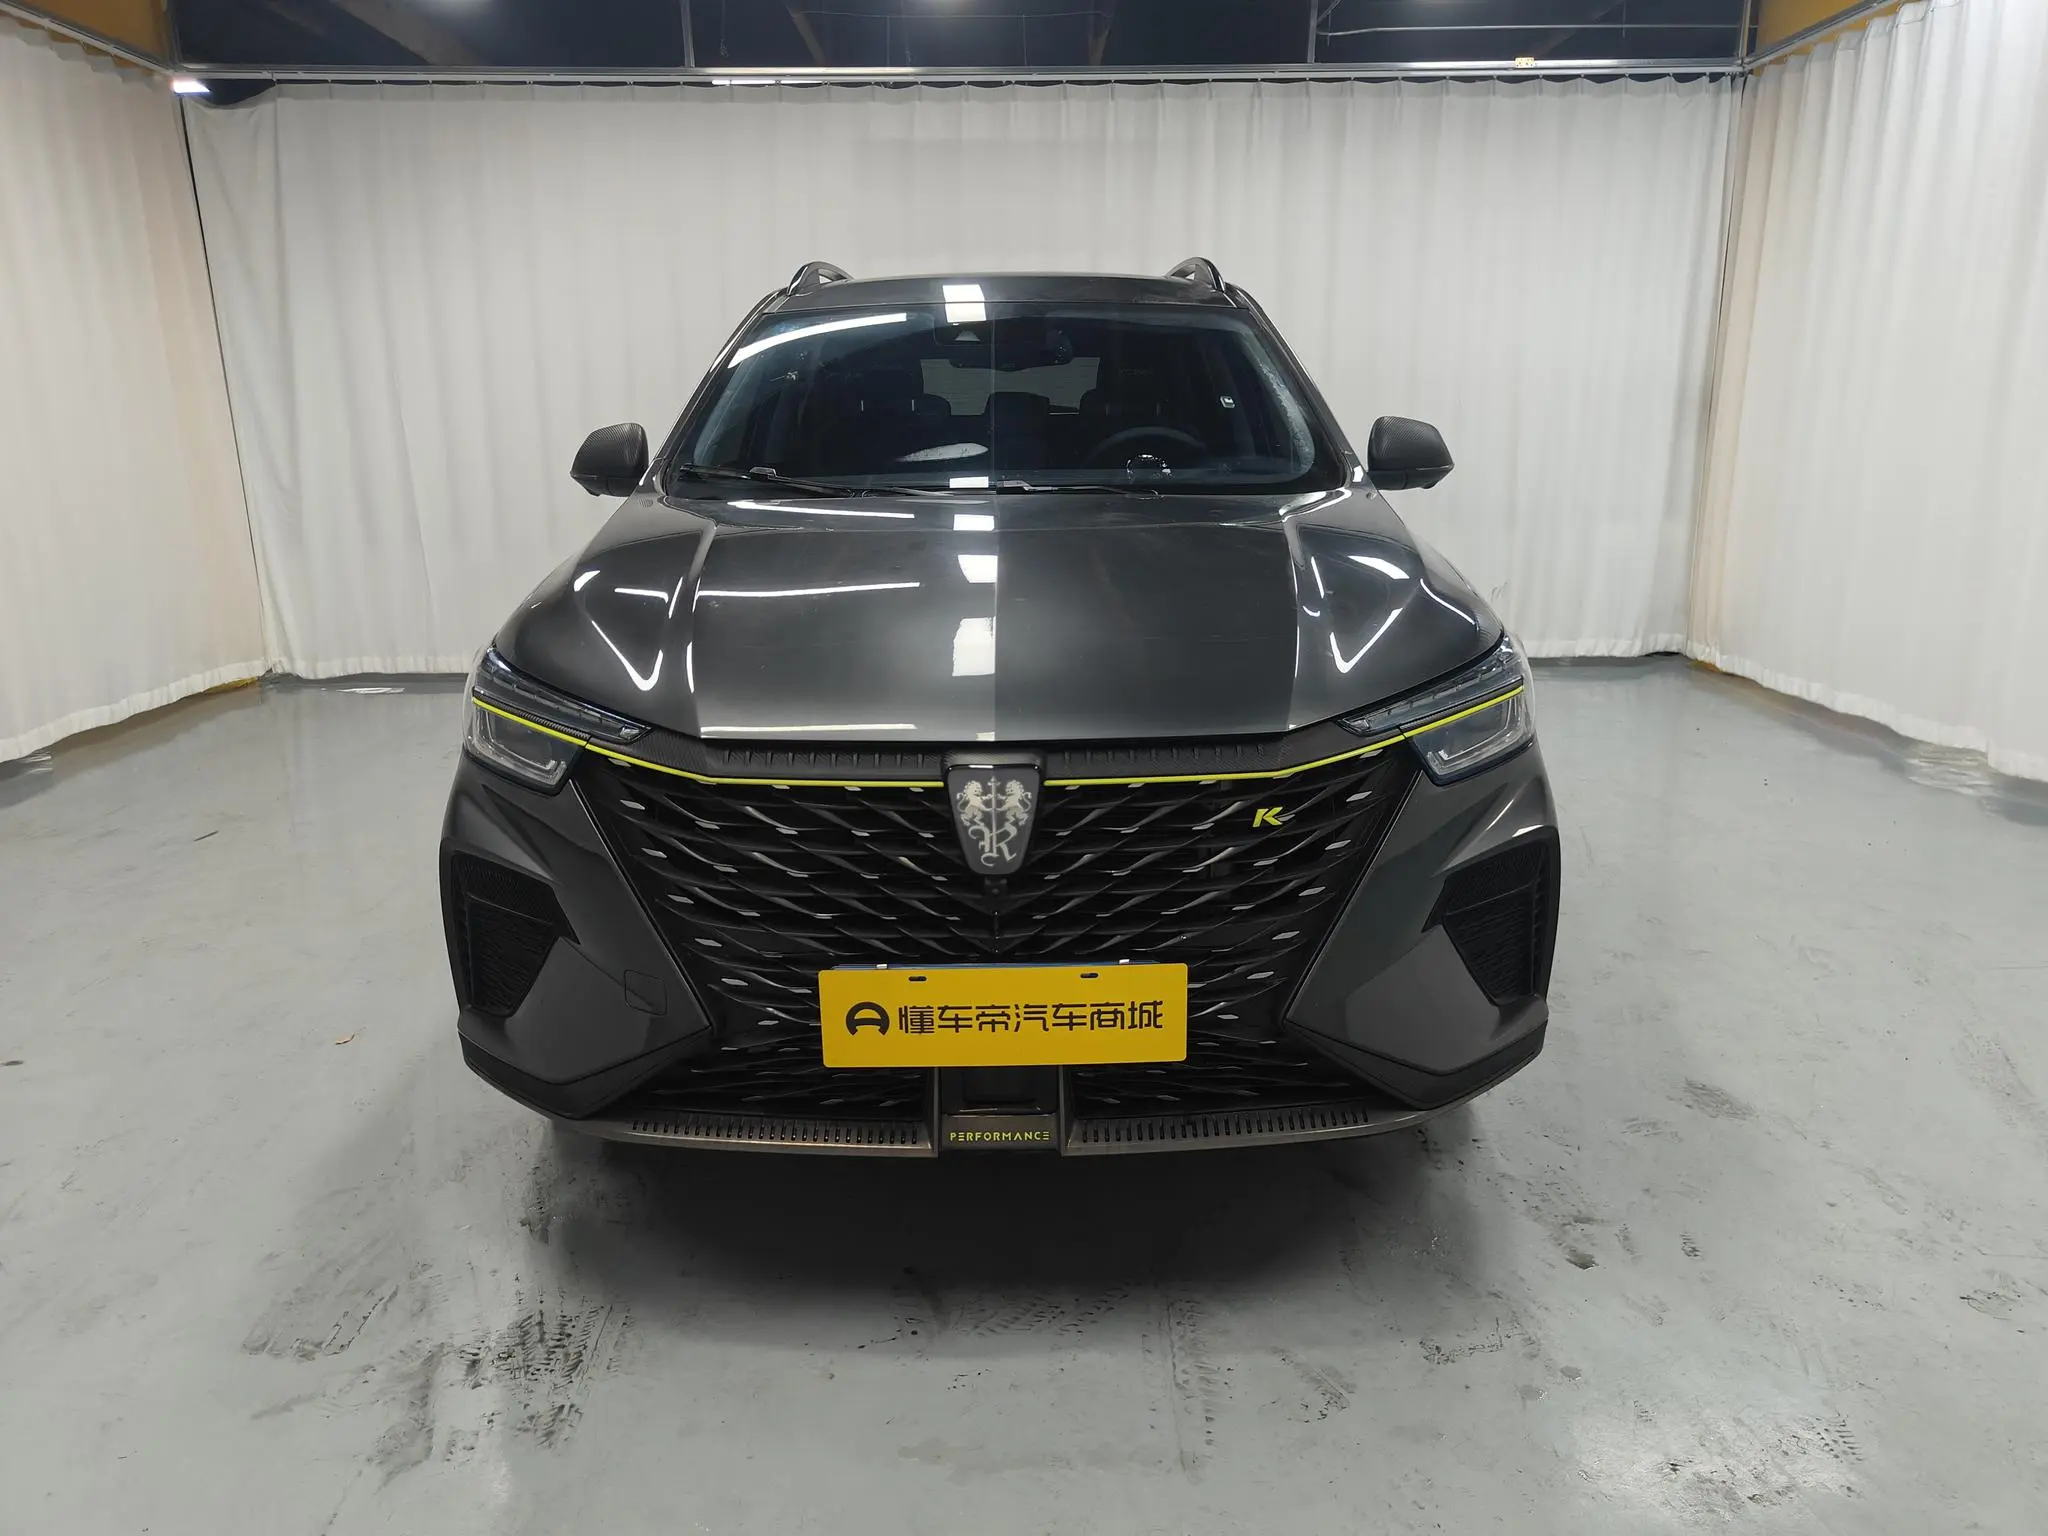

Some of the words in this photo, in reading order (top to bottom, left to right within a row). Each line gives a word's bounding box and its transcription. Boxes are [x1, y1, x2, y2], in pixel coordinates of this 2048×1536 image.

[898, 1000, 1163, 1034] 懂车帝汽车商城
[949, 1131, 1050, 1141] PERFORMANCE
